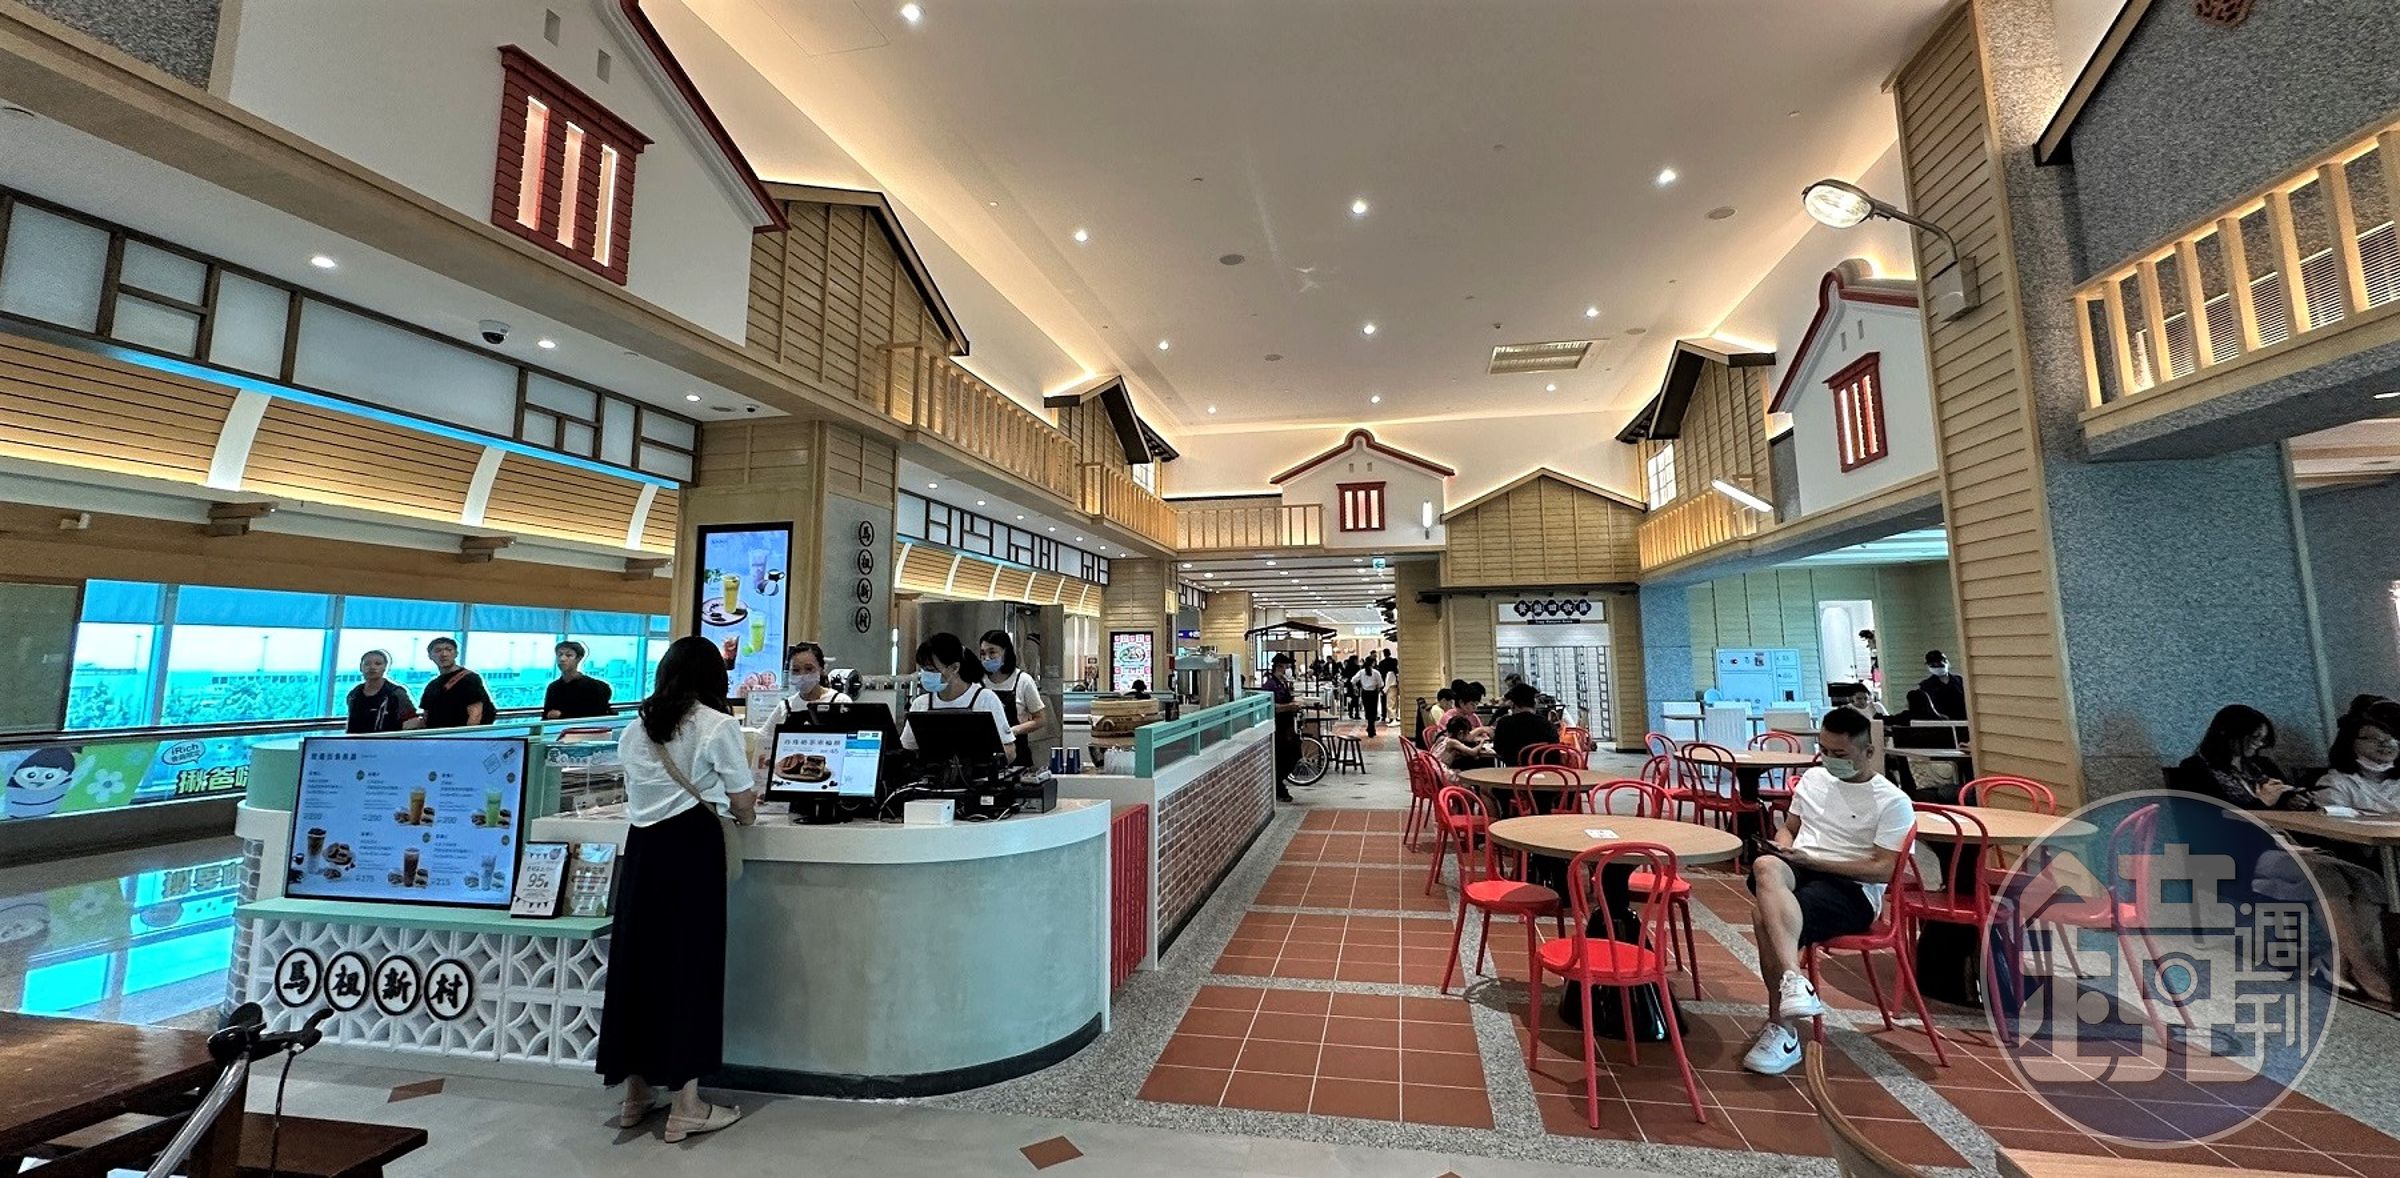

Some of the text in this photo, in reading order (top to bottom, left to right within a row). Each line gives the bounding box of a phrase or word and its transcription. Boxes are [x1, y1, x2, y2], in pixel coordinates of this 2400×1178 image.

[857, 523, 873, 631] 馬祖新村
[281, 957, 466, 1012] 馬祖新村
